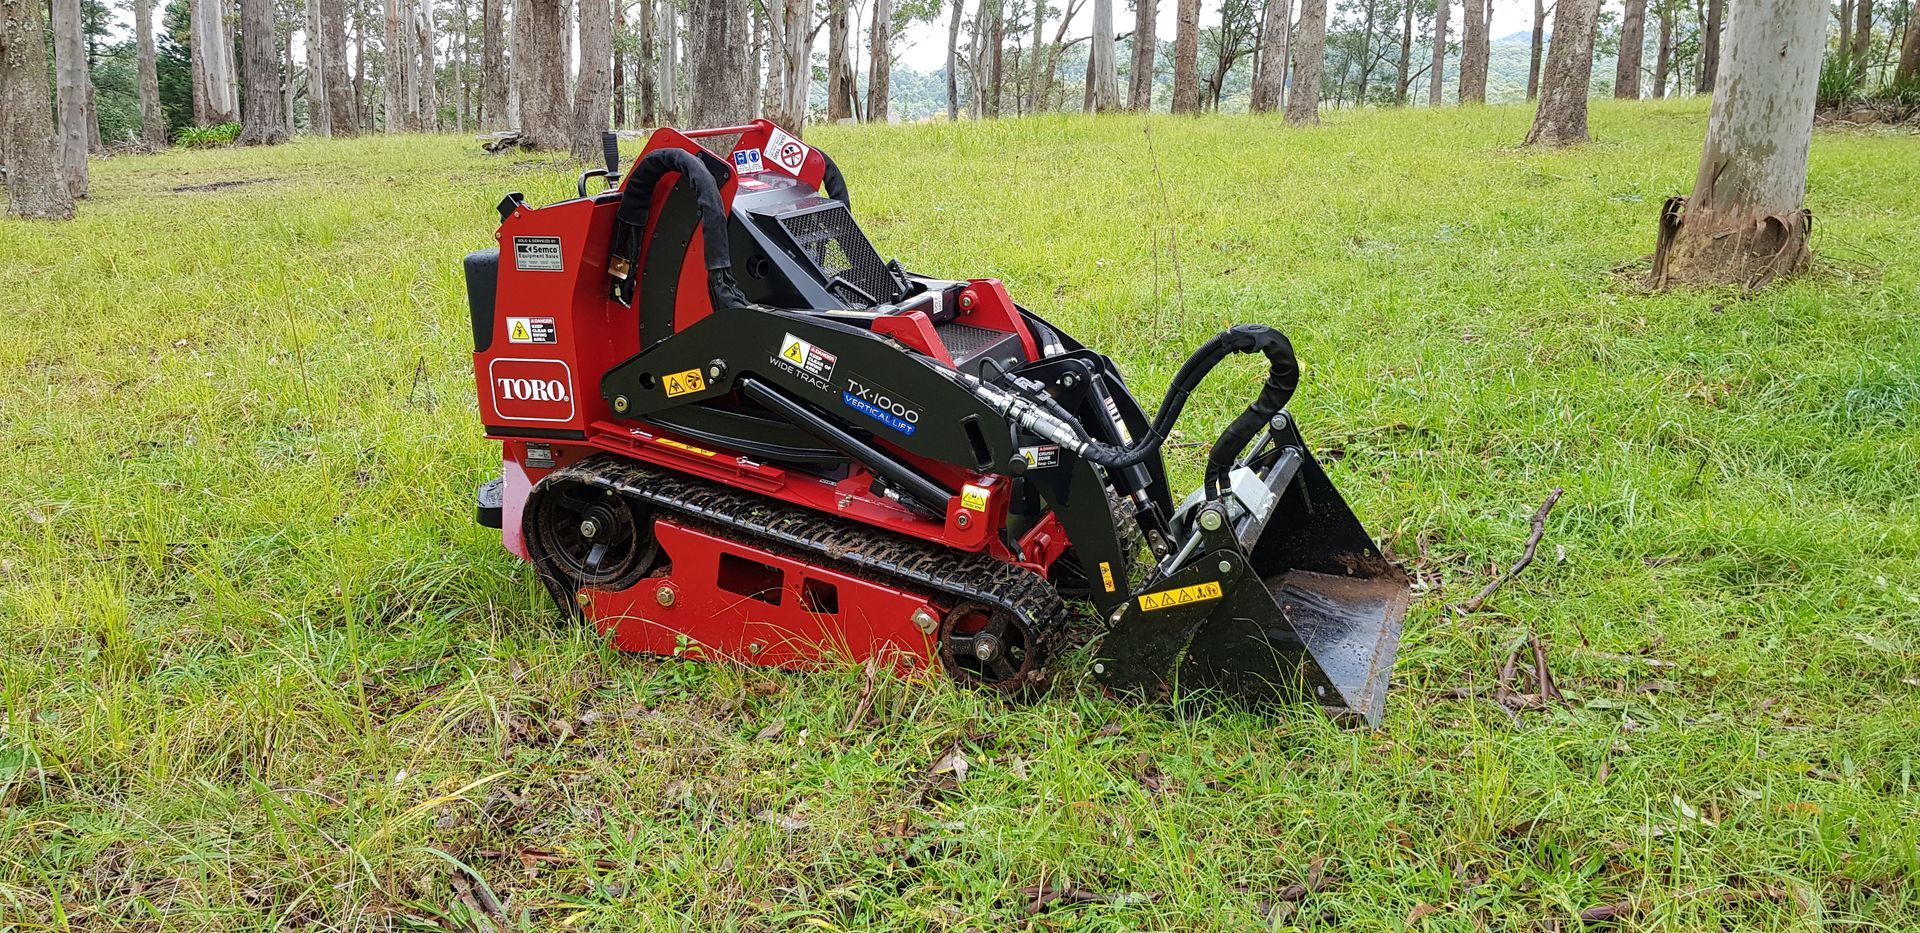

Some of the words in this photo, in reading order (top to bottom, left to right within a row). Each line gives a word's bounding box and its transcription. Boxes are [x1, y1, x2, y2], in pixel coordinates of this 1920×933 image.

[770, 356, 794, 374] WIDE
[796, 370, 829, 392] TRACK
[808, 357, 824, 368] CLEAR
[845, 394, 890, 423] VERTICAL
[892, 420, 912, 433] LIFT
